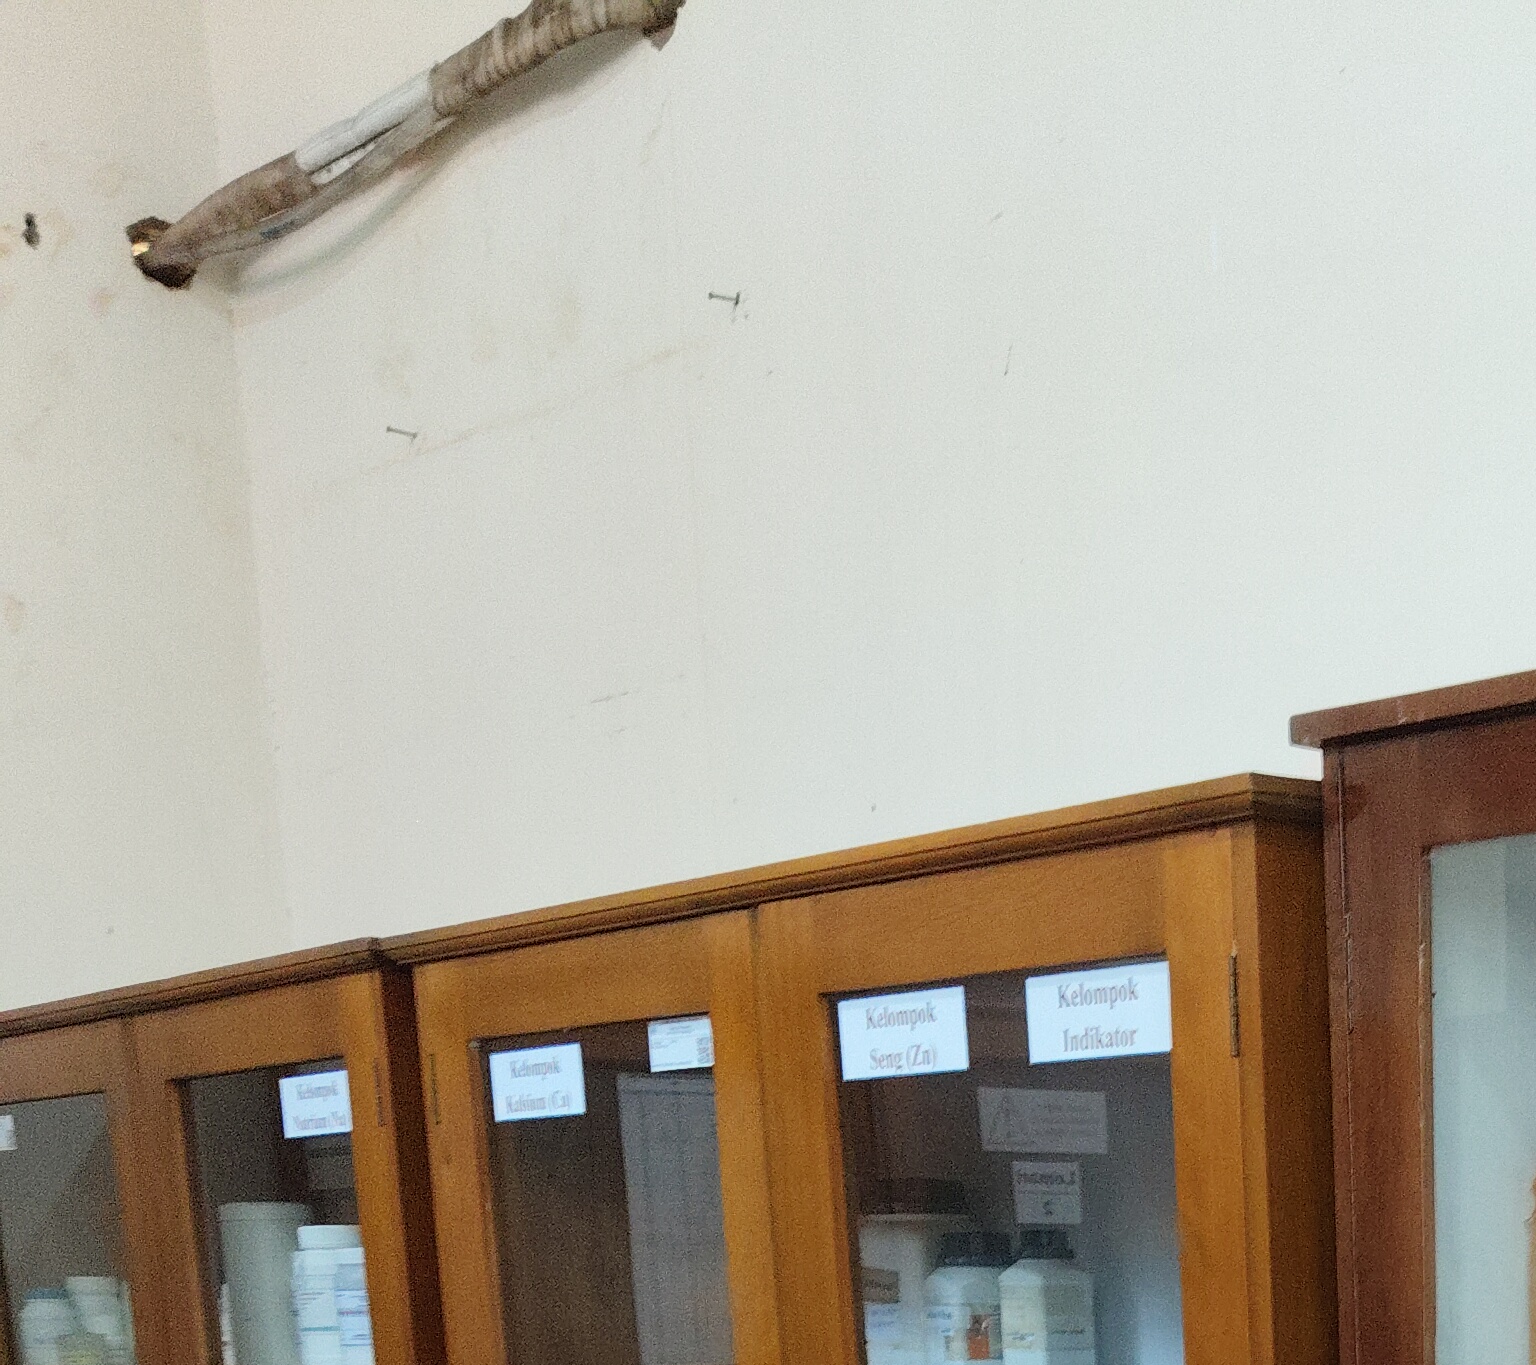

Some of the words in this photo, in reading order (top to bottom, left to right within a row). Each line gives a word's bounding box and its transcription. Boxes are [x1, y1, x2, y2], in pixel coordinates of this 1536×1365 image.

[1056, 976, 1139, 1010] Kelompok
[865, 1001, 937, 1031] Kelompok
[1062, 1025, 1138, 1053] Indikator
[869, 1048, 904, 1073] Seng
[906, 1043, 937, 1071] (Zn)
